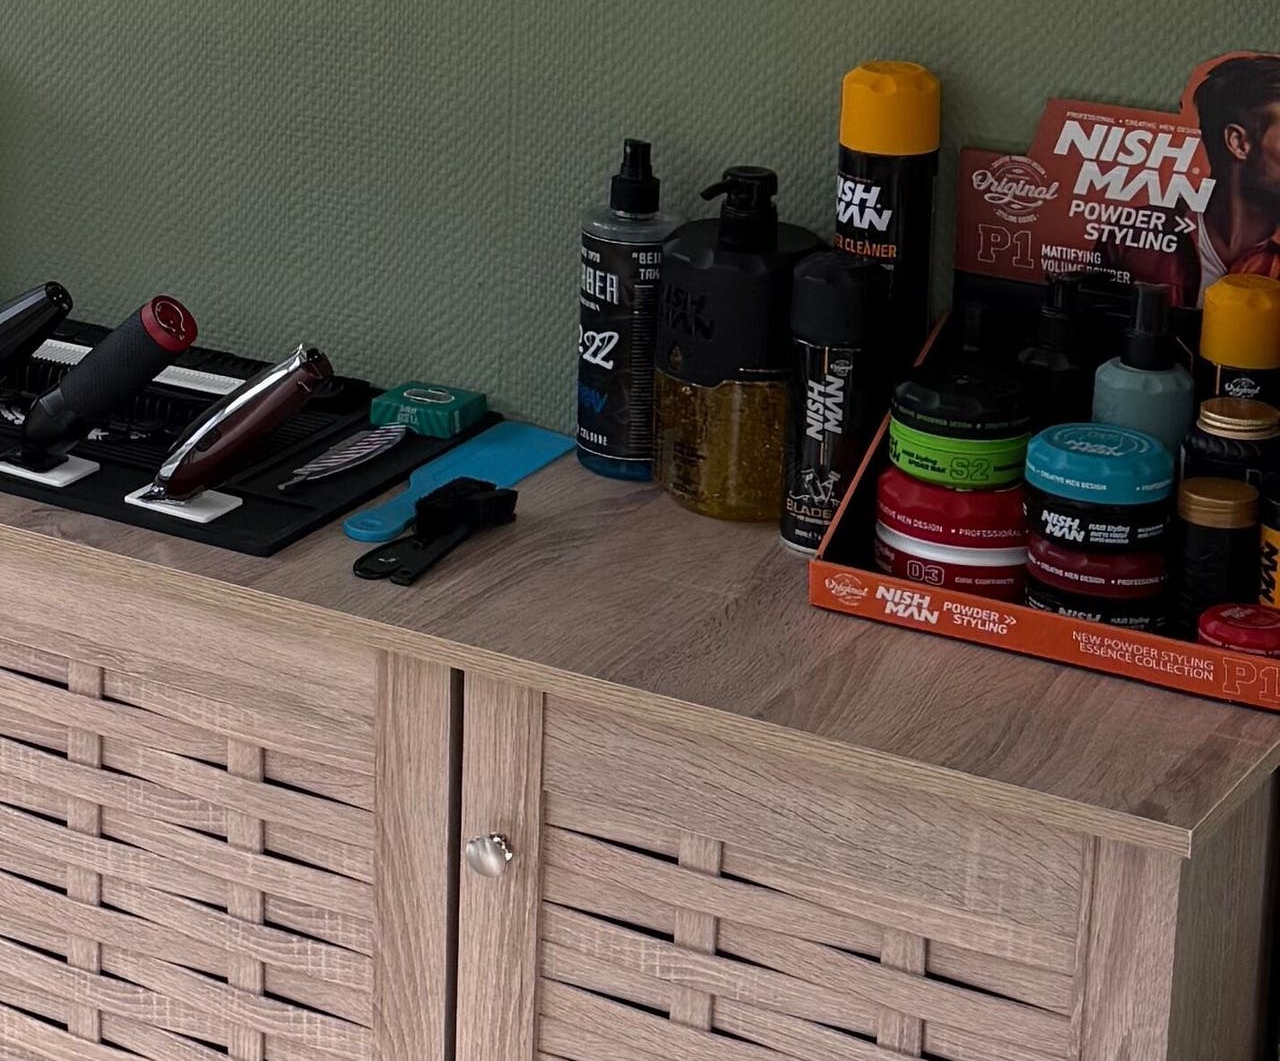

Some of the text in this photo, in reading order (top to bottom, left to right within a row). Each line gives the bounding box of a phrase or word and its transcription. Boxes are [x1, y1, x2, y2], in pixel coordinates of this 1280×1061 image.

[1053, 120, 1201, 173] NISH
[972, 169, 1059, 208] Original
[1072, 160, 1217, 213] MAN
[1068, 200, 1166, 232] POWDER
[845, 238, 897, 258] CLEANER
[977, 223, 1035, 269] P1
[1083, 223, 1178, 253] STYLING
[1041, 243, 1102, 264] MATTIFYING
[806, 379, 826, 441] NISH
[824, 375, 845, 434] MAN
[950, 457, 990, 481] S2
[913, 518, 943, 532] DESIGN
[1041, 510, 1080, 530] NISH
[1045, 521, 1086, 543] MAN
[875, 586, 931, 609] NISH
[884, 602, 939, 625] MAN
[943, 601, 999, 623] POWDER
[953, 615, 1008, 635] STYLING
[1072, 630, 1214, 671] NEW POWDER STYLING
[1079, 642, 1214, 682] ESSENCE COLLECTION
